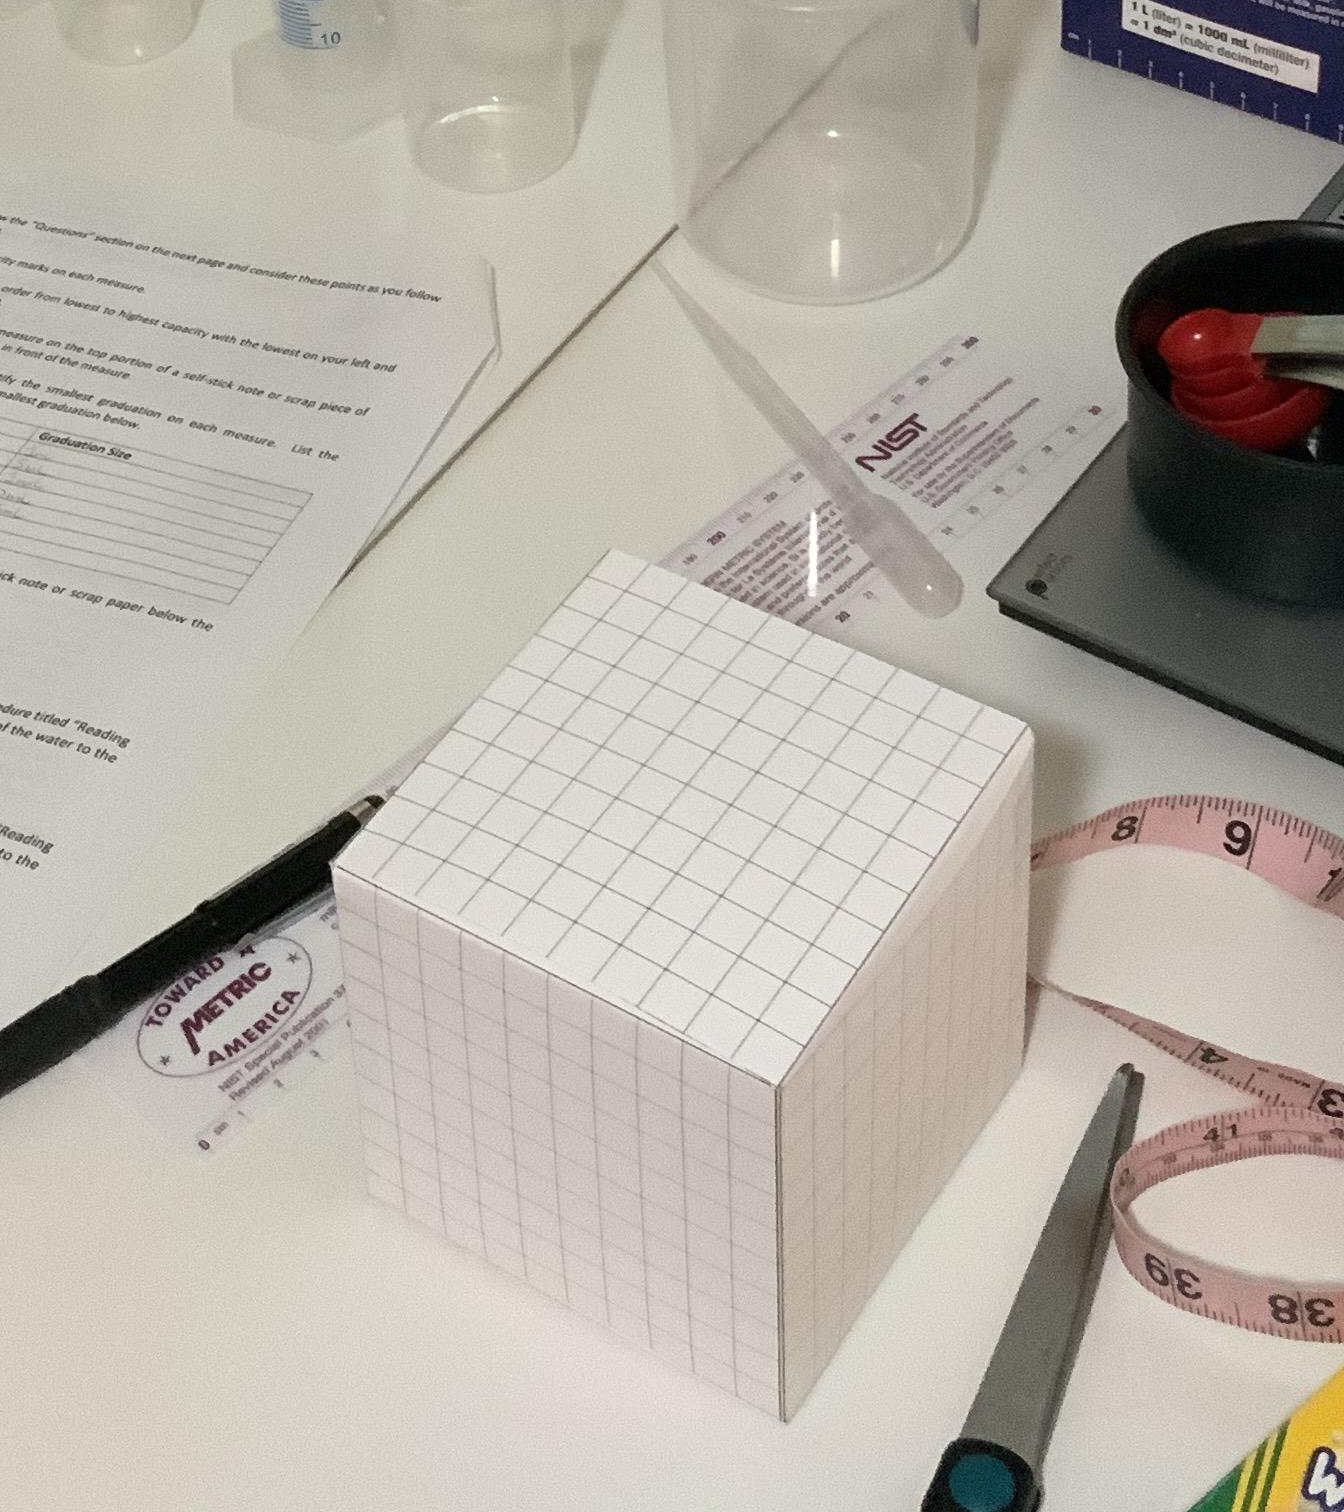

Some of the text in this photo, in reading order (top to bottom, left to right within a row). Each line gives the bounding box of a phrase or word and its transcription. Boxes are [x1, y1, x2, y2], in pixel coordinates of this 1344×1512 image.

[320, 32, 342, 47] 10
[1151, 7, 1183, 30] (liter)
[1198, 24, 1230, 44] 1000
[1231, 34, 1251, 51] mL
[1252, 40, 1312, 71] (milliliter)
[1180, 32, 1215, 56] (cubic
[1216, 44, 1281, 77] decimeter)
[8, 216, 28, 226] the
[93, 234, 134, 248] section
[150, 245, 171, 257] the
[171, 250, 198, 262] next
[195, 257, 226, 268] page
[225, 262, 251, 272] and
[248, 267, 298, 280] consider
[297, 274, 330, 286] these
[329, 280, 367, 292] points
[381, 287, 404, 296] you
[404, 288, 442, 302] follow
[38, 431, 132, 460] Graduation Size
[855, 412, 928, 474] NIST
[1110, 815, 1140, 842] 8
[1223, 819, 1254, 857] 9
[144, 955, 226, 1029] TOWARD
[178, 961, 274, 1057] METRIC
[207, 989, 302, 1068] AMERICA
[217, 995, 336, 1093] NIST Special Publication
[228, 1067, 271, 1102] Revised
[269, 1037, 305, 1071] August
[1267, 1293, 1336, 1329] 38
